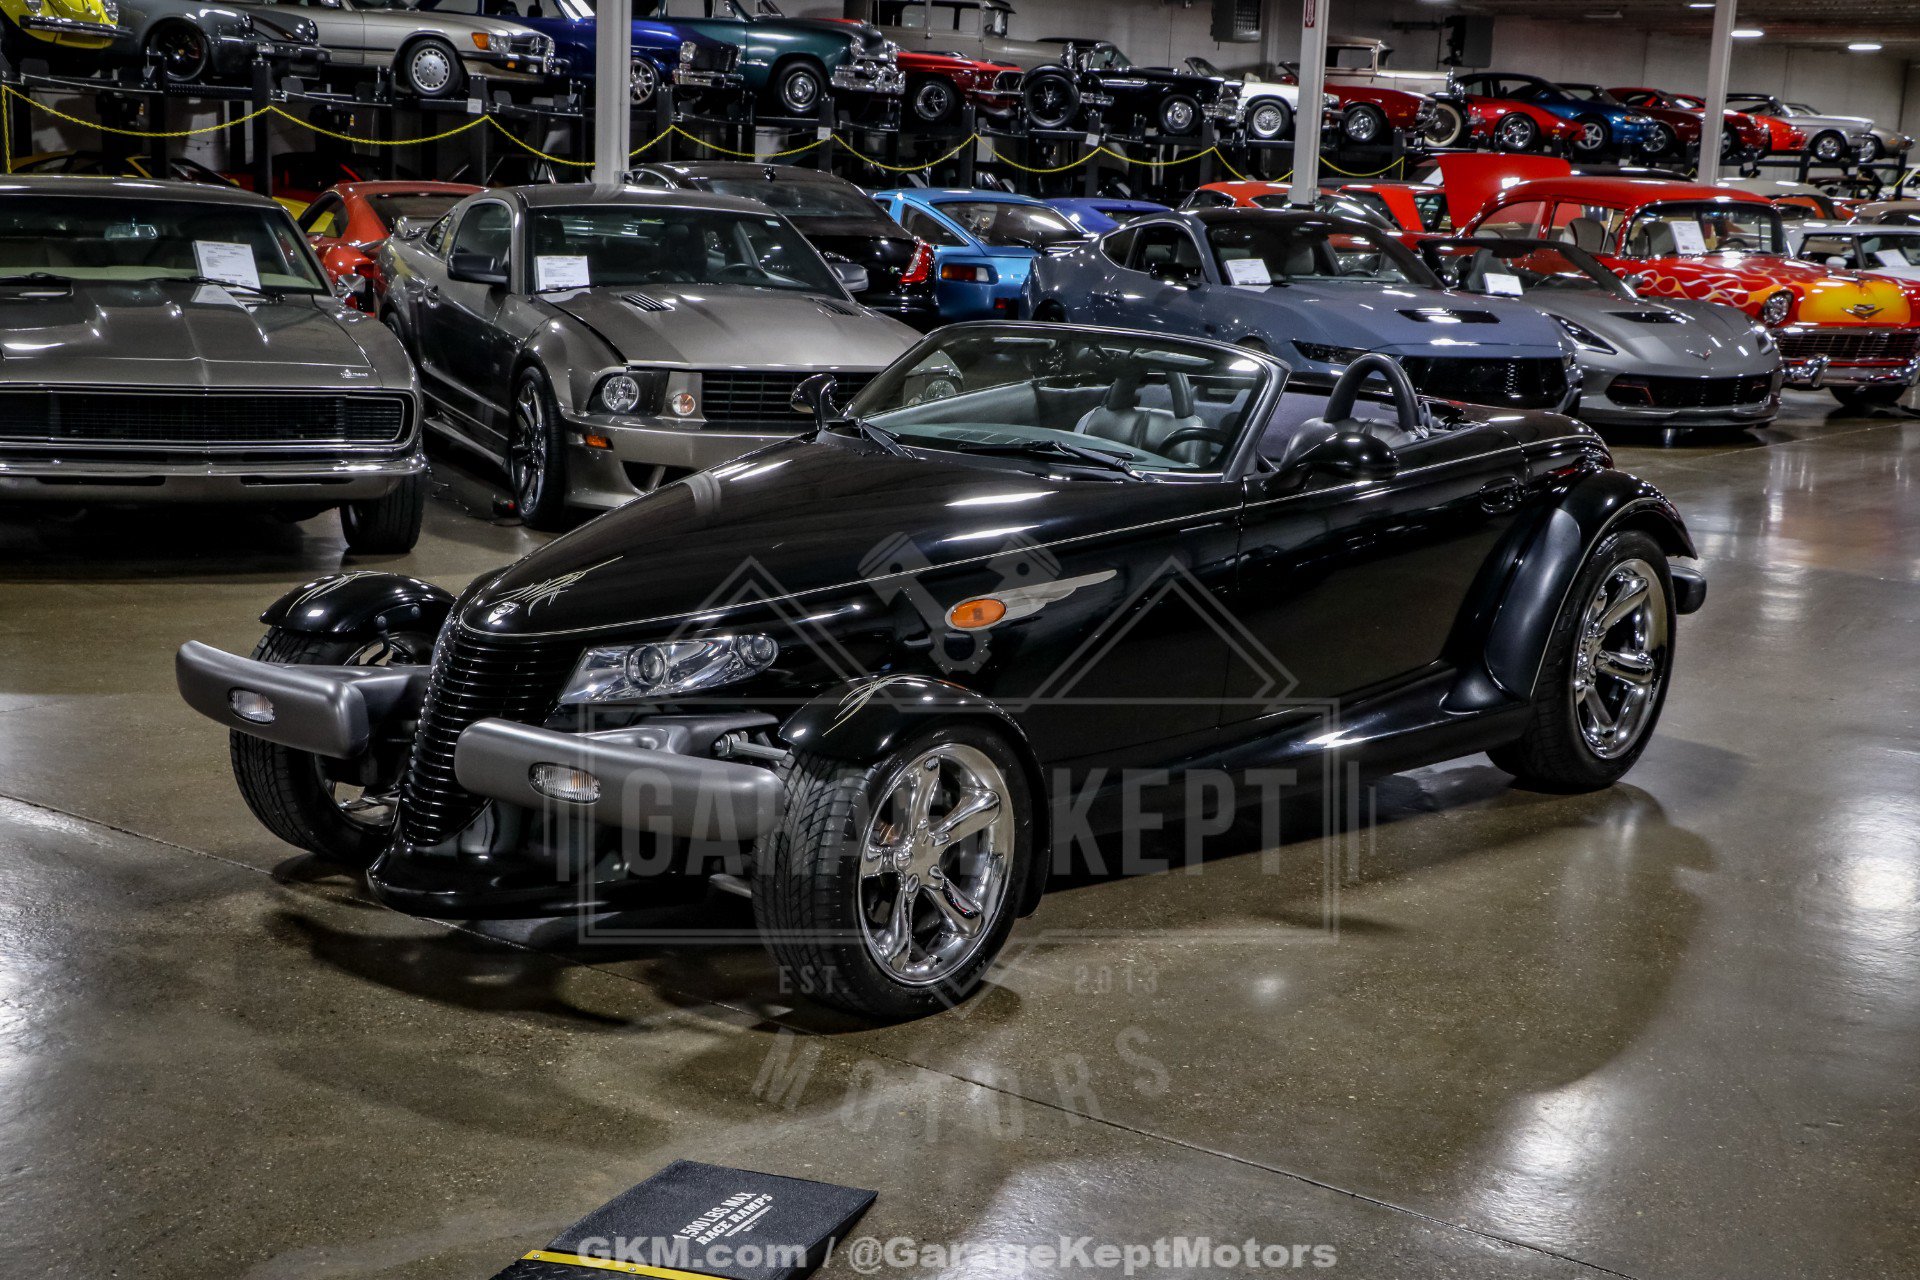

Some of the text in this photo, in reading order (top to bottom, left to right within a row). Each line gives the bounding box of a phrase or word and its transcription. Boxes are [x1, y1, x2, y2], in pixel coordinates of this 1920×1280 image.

[721, 1192, 757, 1208] MAX
[695, 1220, 733, 1245] RACE
[728, 1193, 773, 1223] RAMPS
